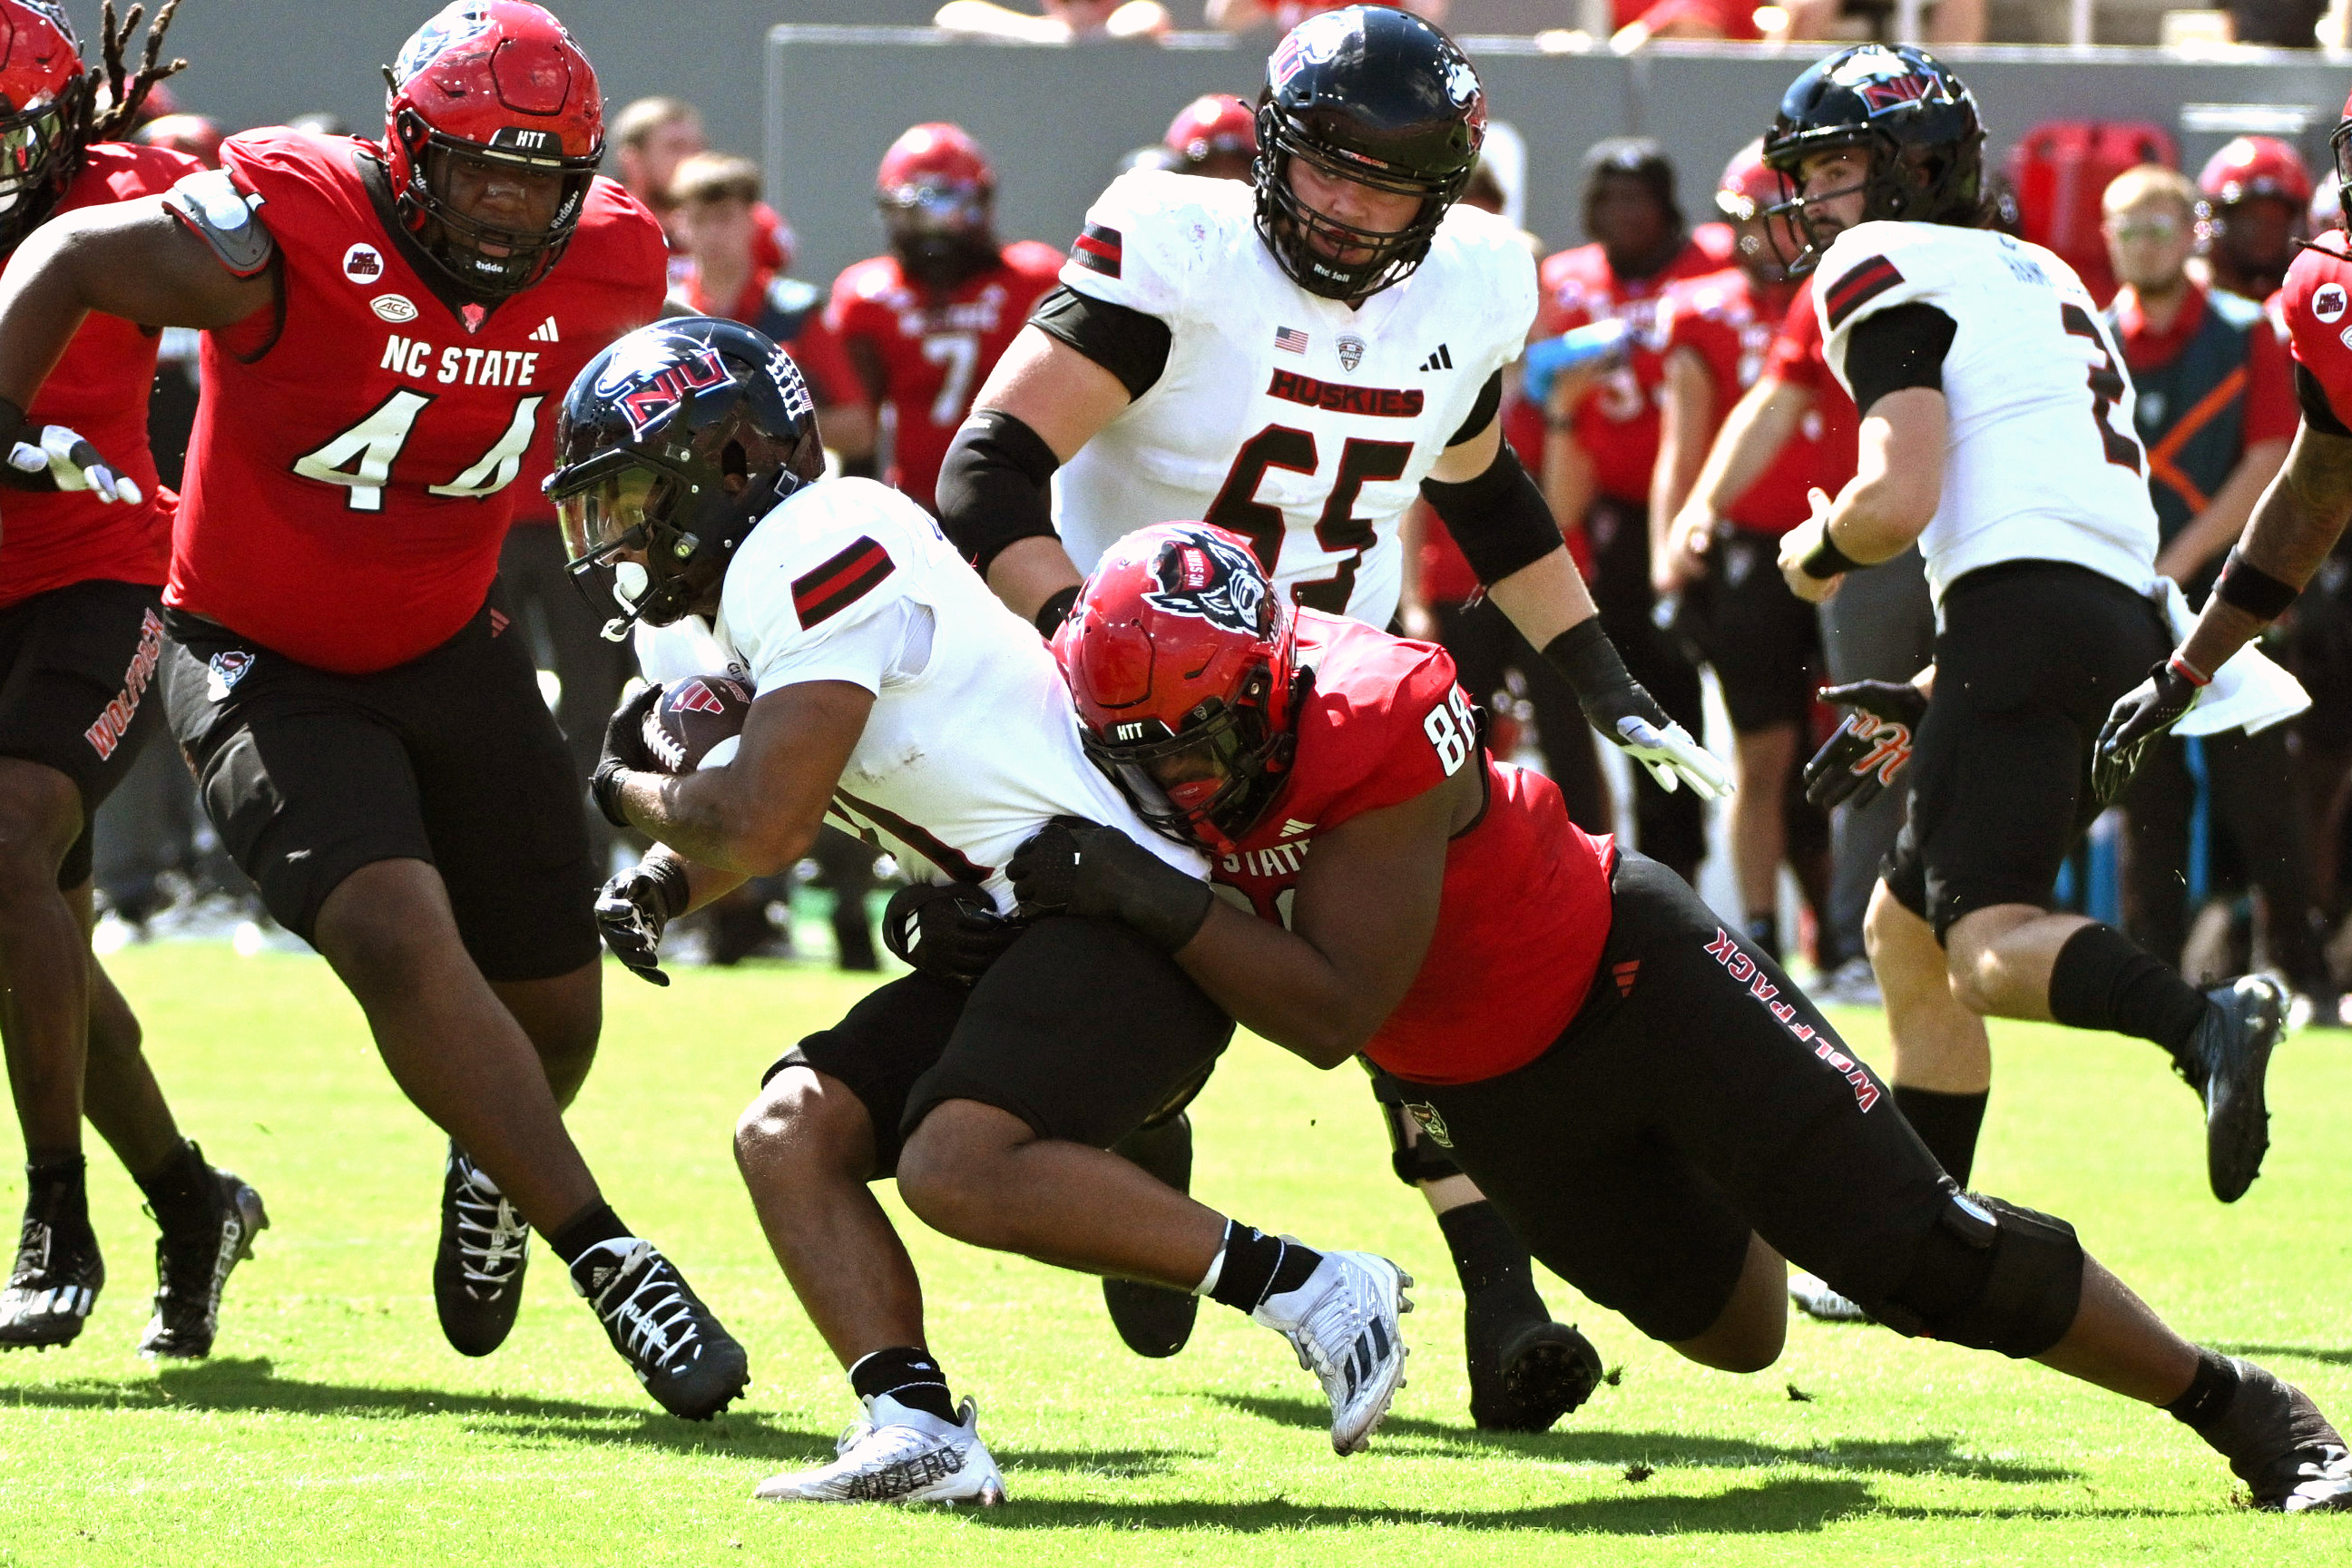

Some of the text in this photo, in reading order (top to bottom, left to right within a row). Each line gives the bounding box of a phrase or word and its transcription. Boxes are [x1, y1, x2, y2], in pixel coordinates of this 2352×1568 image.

[515, 130, 546, 149] HTT
[381, 300, 411, 316] ACC
[380, 334, 540, 386] NC STATE
[625, 352, 725, 426] NIU
[922, 331, 979, 426] 7
[1266, 367, 1425, 418] HUSKIES
[288, 385, 549, 514] 44
[1202, 423, 1415, 616] 65
[1183, 549, 1205, 587] NC STATE
[84, 606, 165, 761] WOLFPACK
[1117, 722, 1143, 740] HTT
[1703, 926, 1881, 1114] WOLFPACK
